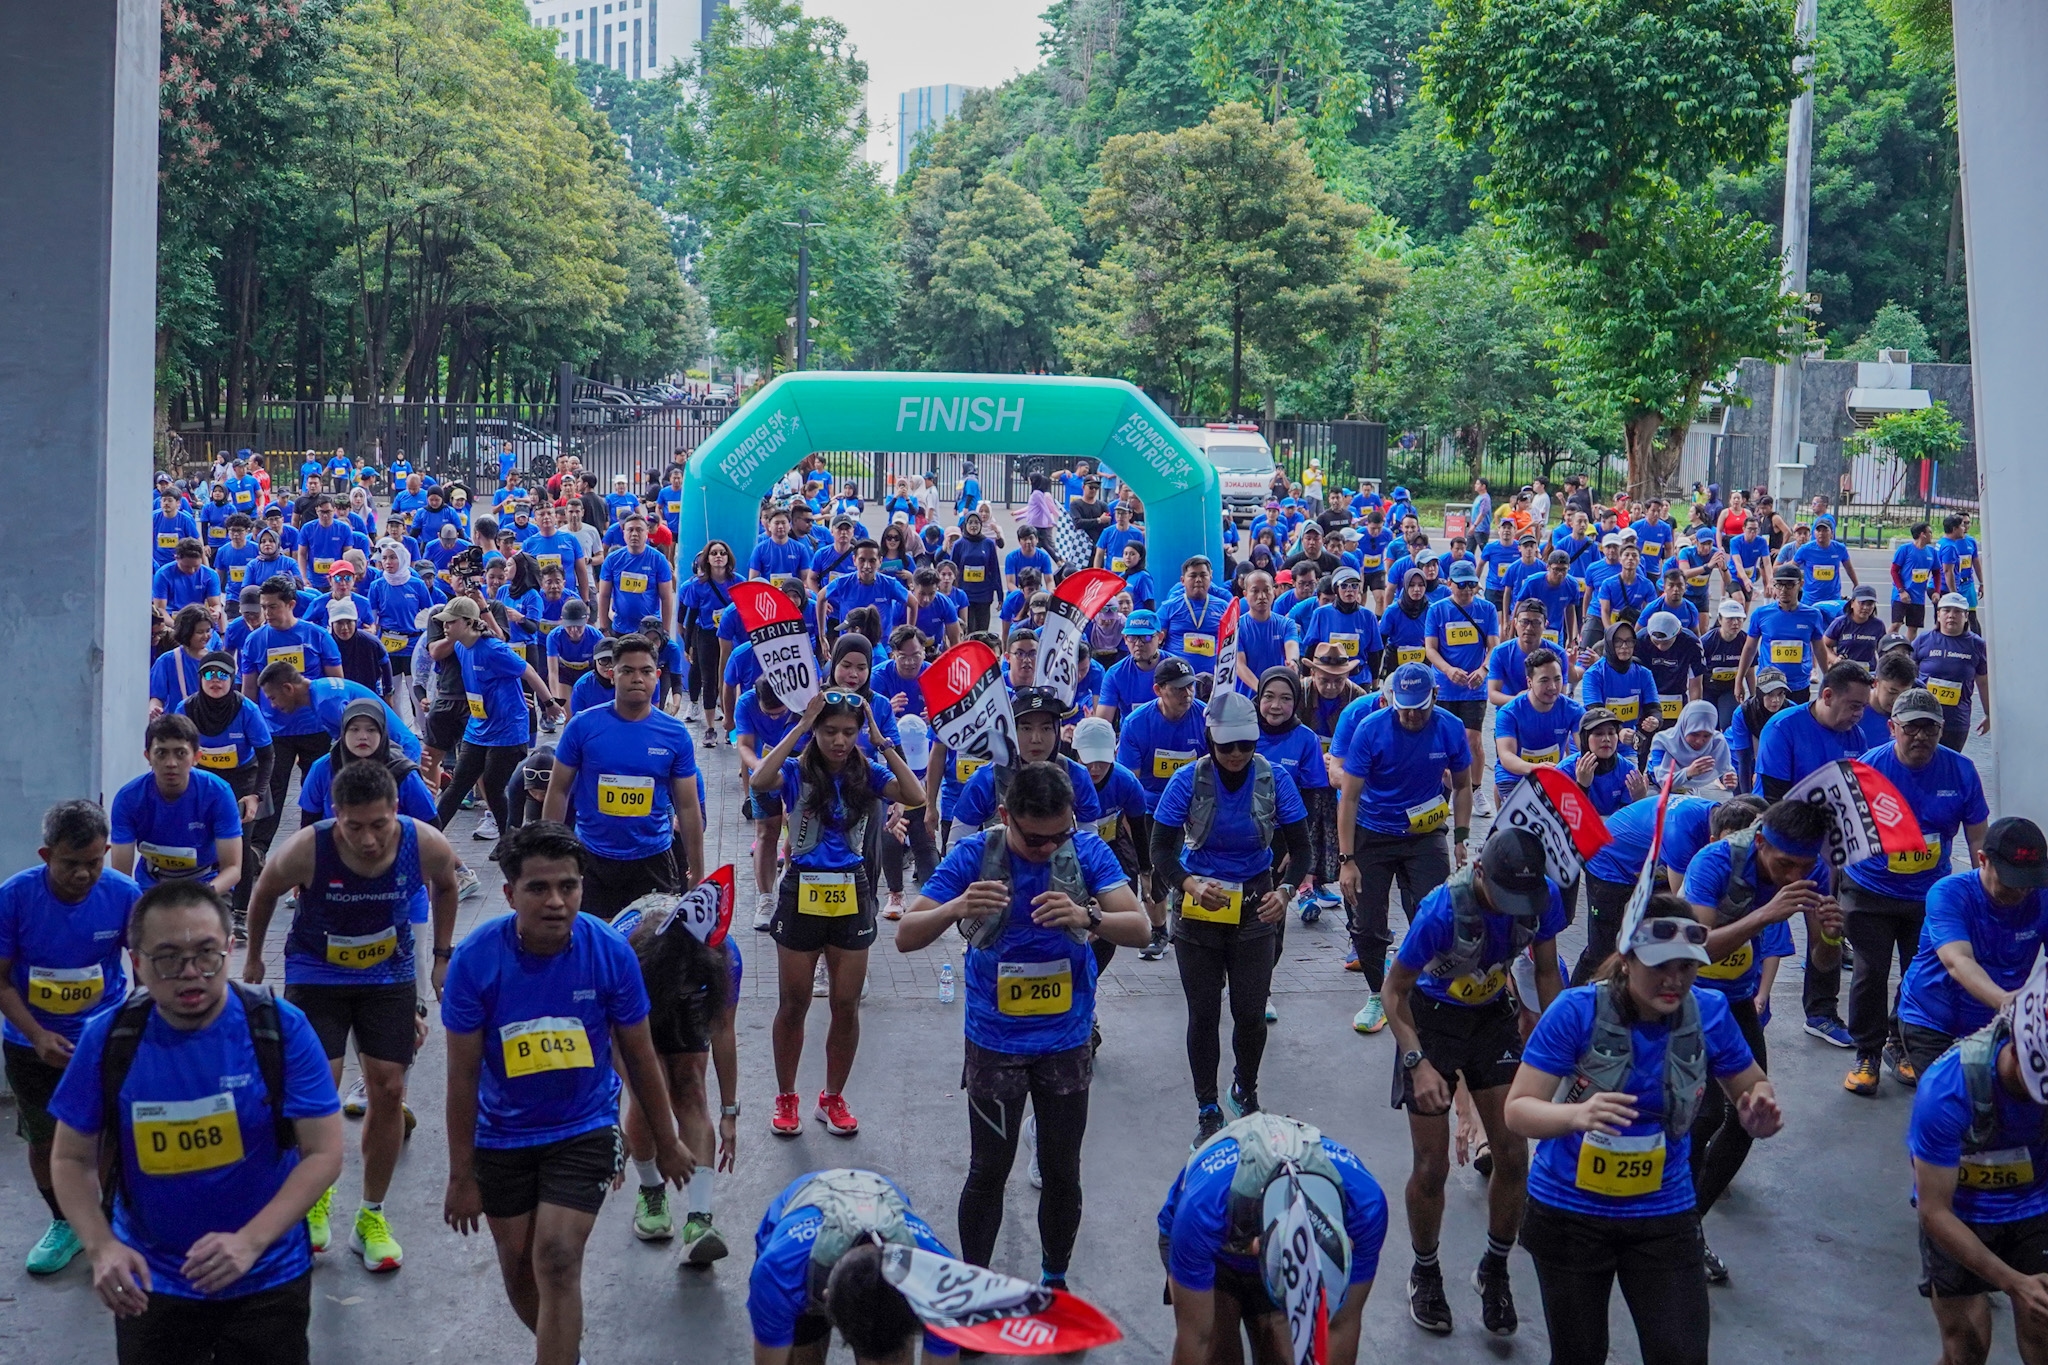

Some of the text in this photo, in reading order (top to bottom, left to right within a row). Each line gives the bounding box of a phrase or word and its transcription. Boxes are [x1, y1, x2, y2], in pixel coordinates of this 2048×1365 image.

[896, 396, 1025, 432] FINISH
[719, 408, 788, 475] KOMDIGI 5K
[1111, 433, 1125, 447] 2024
[1128, 412, 1194, 477] KOMDIGI 5K
[729, 429, 787, 486] FUN RUN
[1117, 422, 1175, 478] FUN RUN
[751, 621, 800, 645] STRIVE
[1458, 630, 1472, 638] 004
[762, 644, 801, 667] PACE
[1402, 652, 1422, 661] D 209
[1784, 649, 1797, 657] 075
[1947, 651, 1972, 660] Salonpas
[932, 669, 994, 730] STRIVE
[1932, 687, 1955, 698] D 273
[1621, 706, 1633, 715] 014
[1663, 704, 1677, 712] 275
[948, 697, 997, 747] PACE
[964, 765, 970, 774] E
[1161, 761, 1168, 770] B
[606, 791, 644, 805] D 090
[1416, 810, 1444, 828] A 004
[1828, 784, 1860, 852] PACE
[1844, 770, 1882, 855] STRIVE
[798, 816, 809, 848] STRIVE
[1526, 800, 1571, 868] PACE
[1898, 850, 1932, 862] A 016
[809, 889, 847, 903] D 253
[339, 944, 386, 962] C 046
[41, 985, 92, 1001] D 080
[1011, 982, 1061, 1001] D 260
[1461, 984, 1473, 997] D
[517, 1038, 576, 1058] B 043
[152, 1126, 223, 1153] D 068
[1593, 1155, 1653, 1178] D 259
[1979, 1171, 2018, 1184] 256
